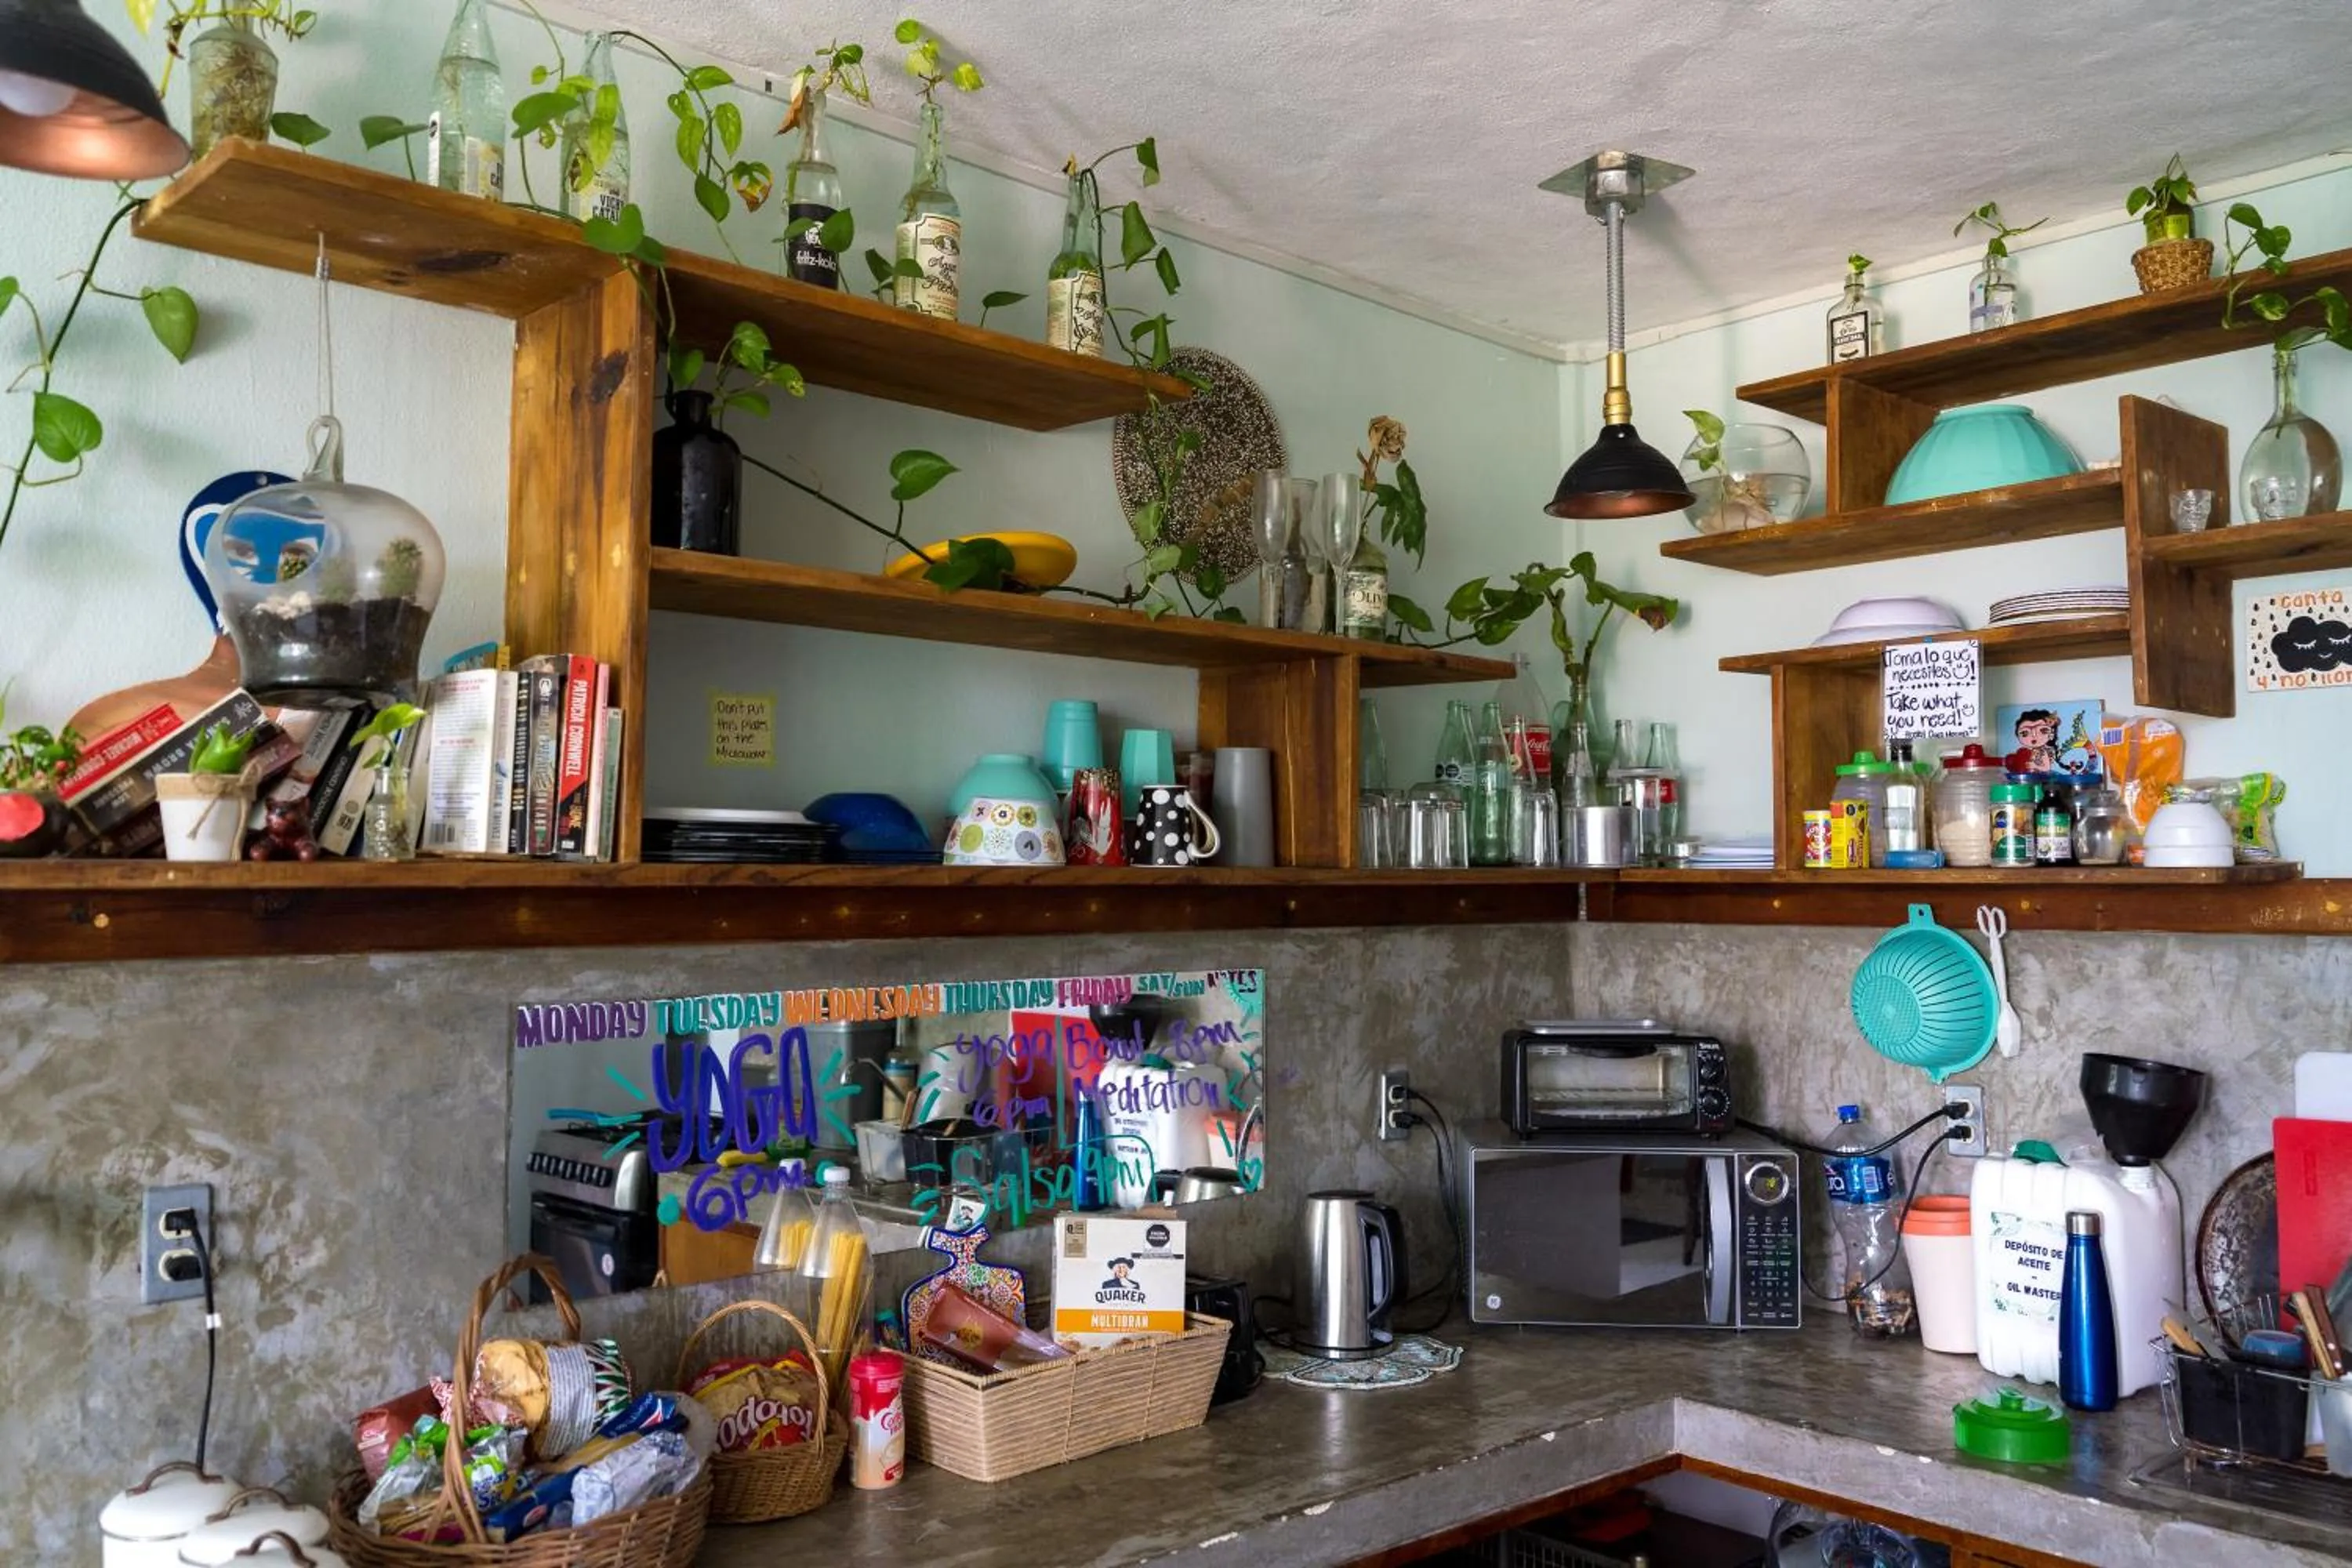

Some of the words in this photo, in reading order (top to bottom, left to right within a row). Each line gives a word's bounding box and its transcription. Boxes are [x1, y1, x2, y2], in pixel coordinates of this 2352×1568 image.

[2281, 591, 2343, 608] canta
[1883, 648, 1921, 666] Toma
[1925, 647, 1940, 665] lo
[1942, 648, 1971, 666] que
[2280, 674, 2307, 687] no
[569, 680, 588, 724] PATRICIA
[1886, 691, 1919, 712] Take
[1922, 691, 1962, 710] what
[1887, 714, 1914, 728] you
[565, 725, 586, 778] CORNWELL
[516, 1001, 648, 1047] MONDAY
[653, 991, 783, 1035] TUESDAY
[784, 983, 941, 1024] WEDNESDAY
[943, 979, 1054, 1014] THURSDAY
[1058, 977, 1132, 1008] FRIDAY
[648, 1027, 818, 1174] YOGA
[2005, 1240, 2049, 1257] DEPÓSITO
[2050, 1249, 2064, 1259] DE
[2017, 1256, 2052, 1271] ACEITE
[1095, 1290, 1145, 1304] QUAKER
[2007, 1282, 2021, 1293] OIL
